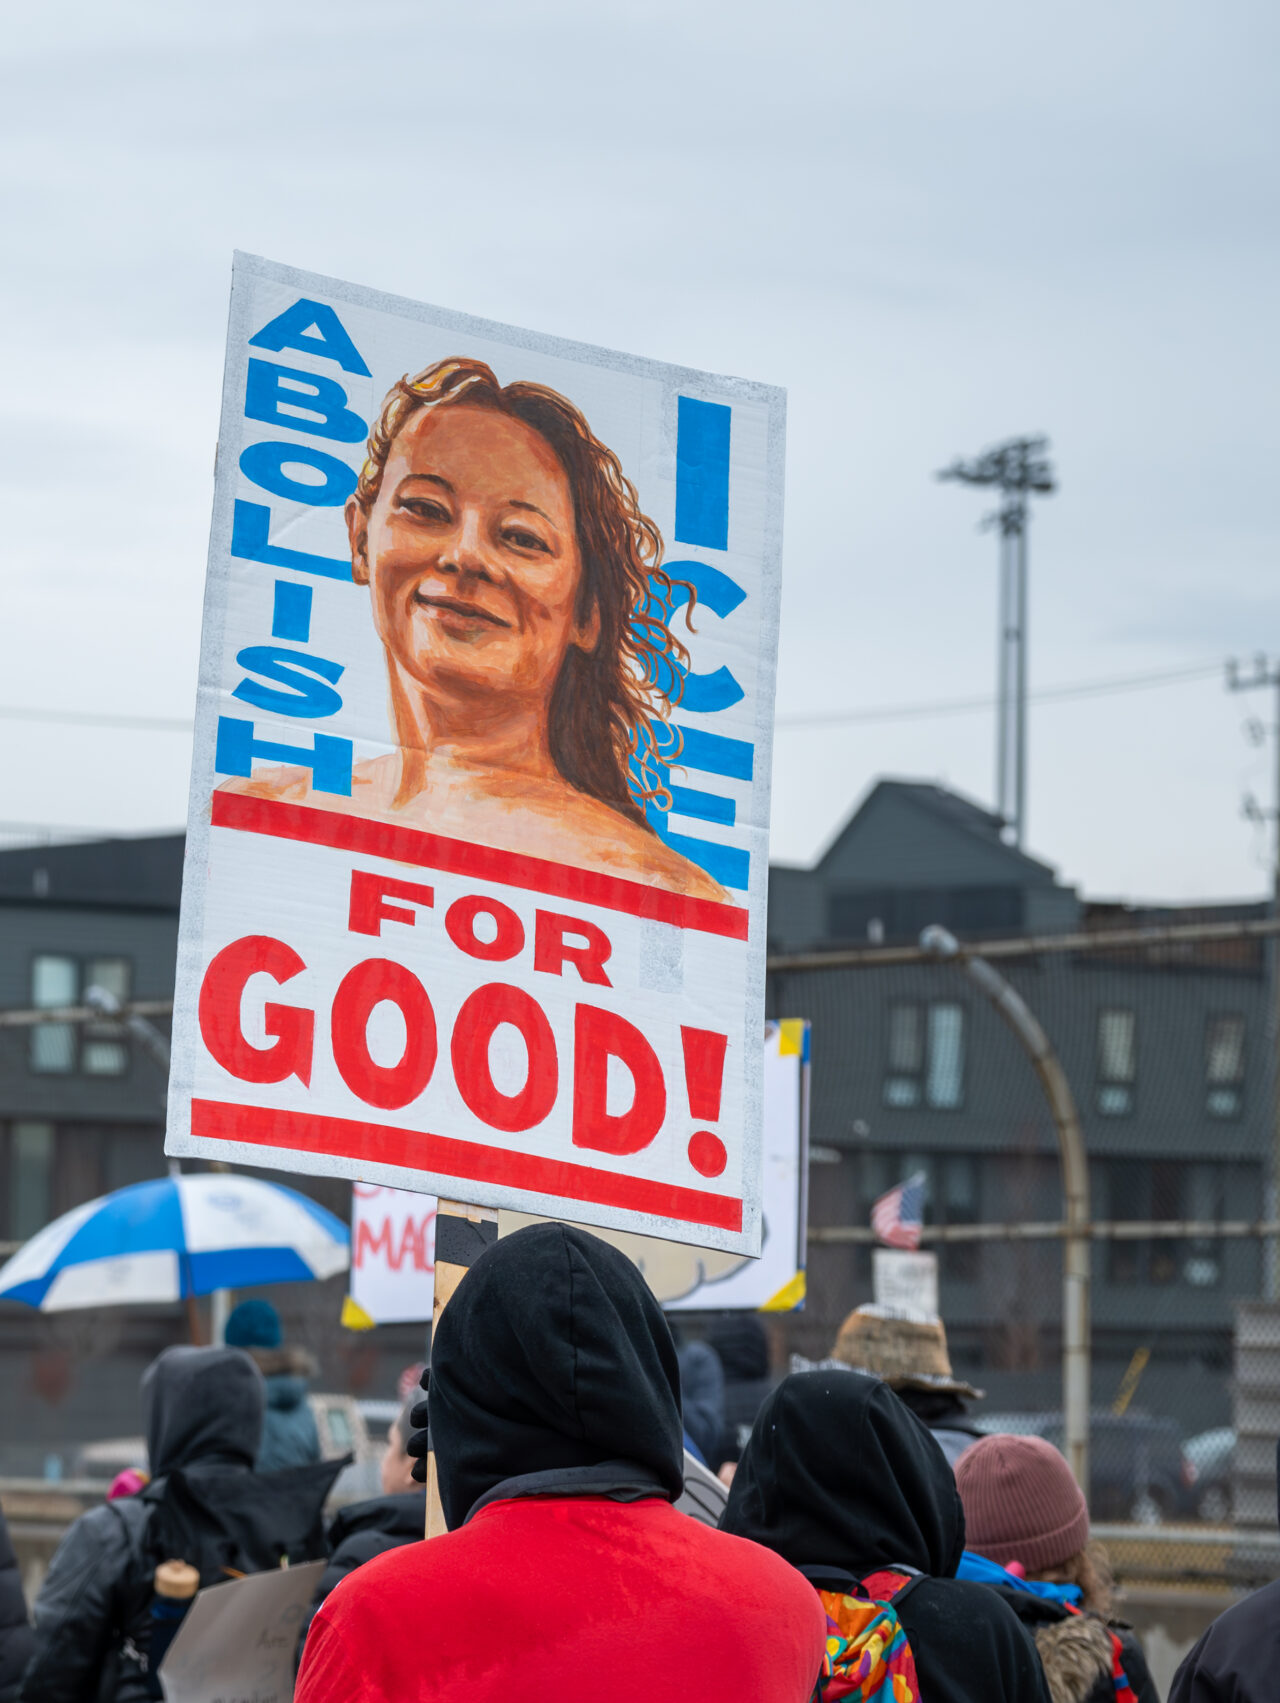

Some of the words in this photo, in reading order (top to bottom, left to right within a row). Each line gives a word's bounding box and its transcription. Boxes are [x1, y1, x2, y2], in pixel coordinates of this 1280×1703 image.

[215, 298, 372, 797] ABOLISH
[629, 395, 754, 891] ICE
[198, 935, 728, 1178] GOOD!
[349, 869, 613, 988] FOR
